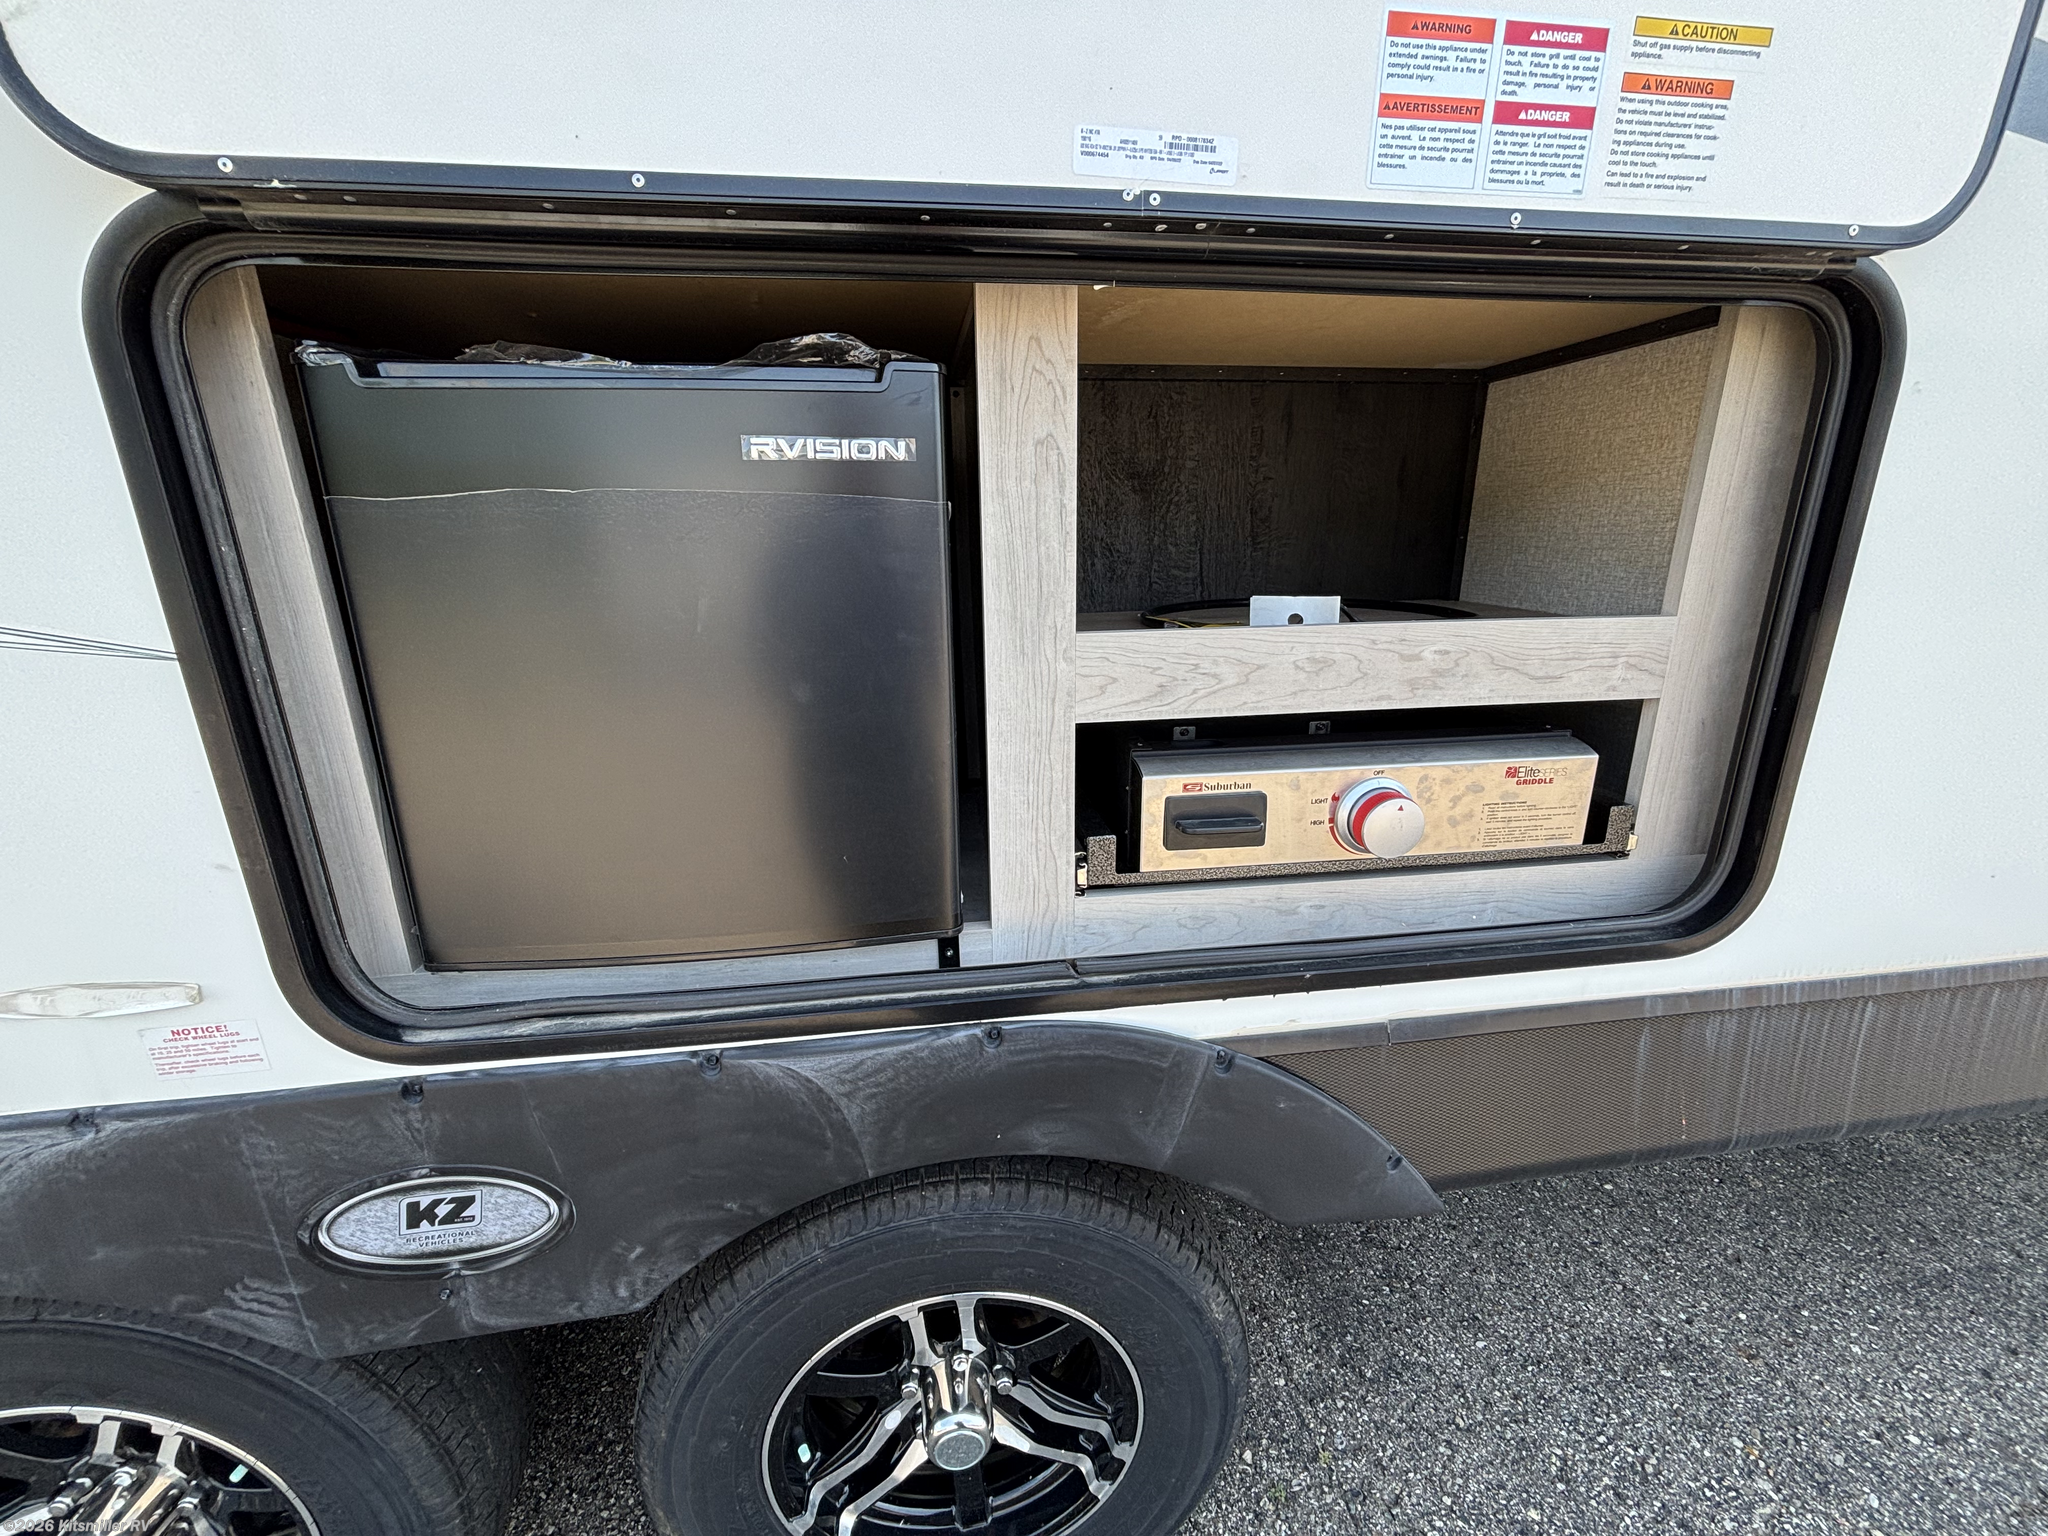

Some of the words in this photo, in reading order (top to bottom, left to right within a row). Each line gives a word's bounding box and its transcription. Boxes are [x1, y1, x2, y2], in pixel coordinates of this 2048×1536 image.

[1420, 21, 1472, 34] WARNING
[1682, 24, 1738, 41] CAUTION
[1539, 30, 1583, 43] DANGER
[1631, 51, 1663, 59] appliance.
[1673, 44, 1693, 53] supply
[1717, 47, 1761, 58] disconnecting
[1421, 54, 1449, 62] awnings.
[1388, 62, 1411, 70] comply
[1539, 72, 1564, 81] resulting
[1573, 75, 1597, 83] property
[1566, 84, 1583, 92] injury
[1655, 79, 1714, 95] WARNING
[1392, 102, 1480, 116] AVERTISSEMENT
[1691, 102, 1713, 110] cooking
[1527, 110, 1570, 122] DANGER
[1655, 140, 1673, 150] during
[750, 438, 906, 460] RVISION
[1204, 782, 1251, 791] Suburban
[171, 1025, 228, 1037] NOTICE!
[406, 1195, 475, 1230] KZ
[406, 1231, 475, 1243] RECREATIONAL
[419, 1238, 463, 1247] VEHICLES
